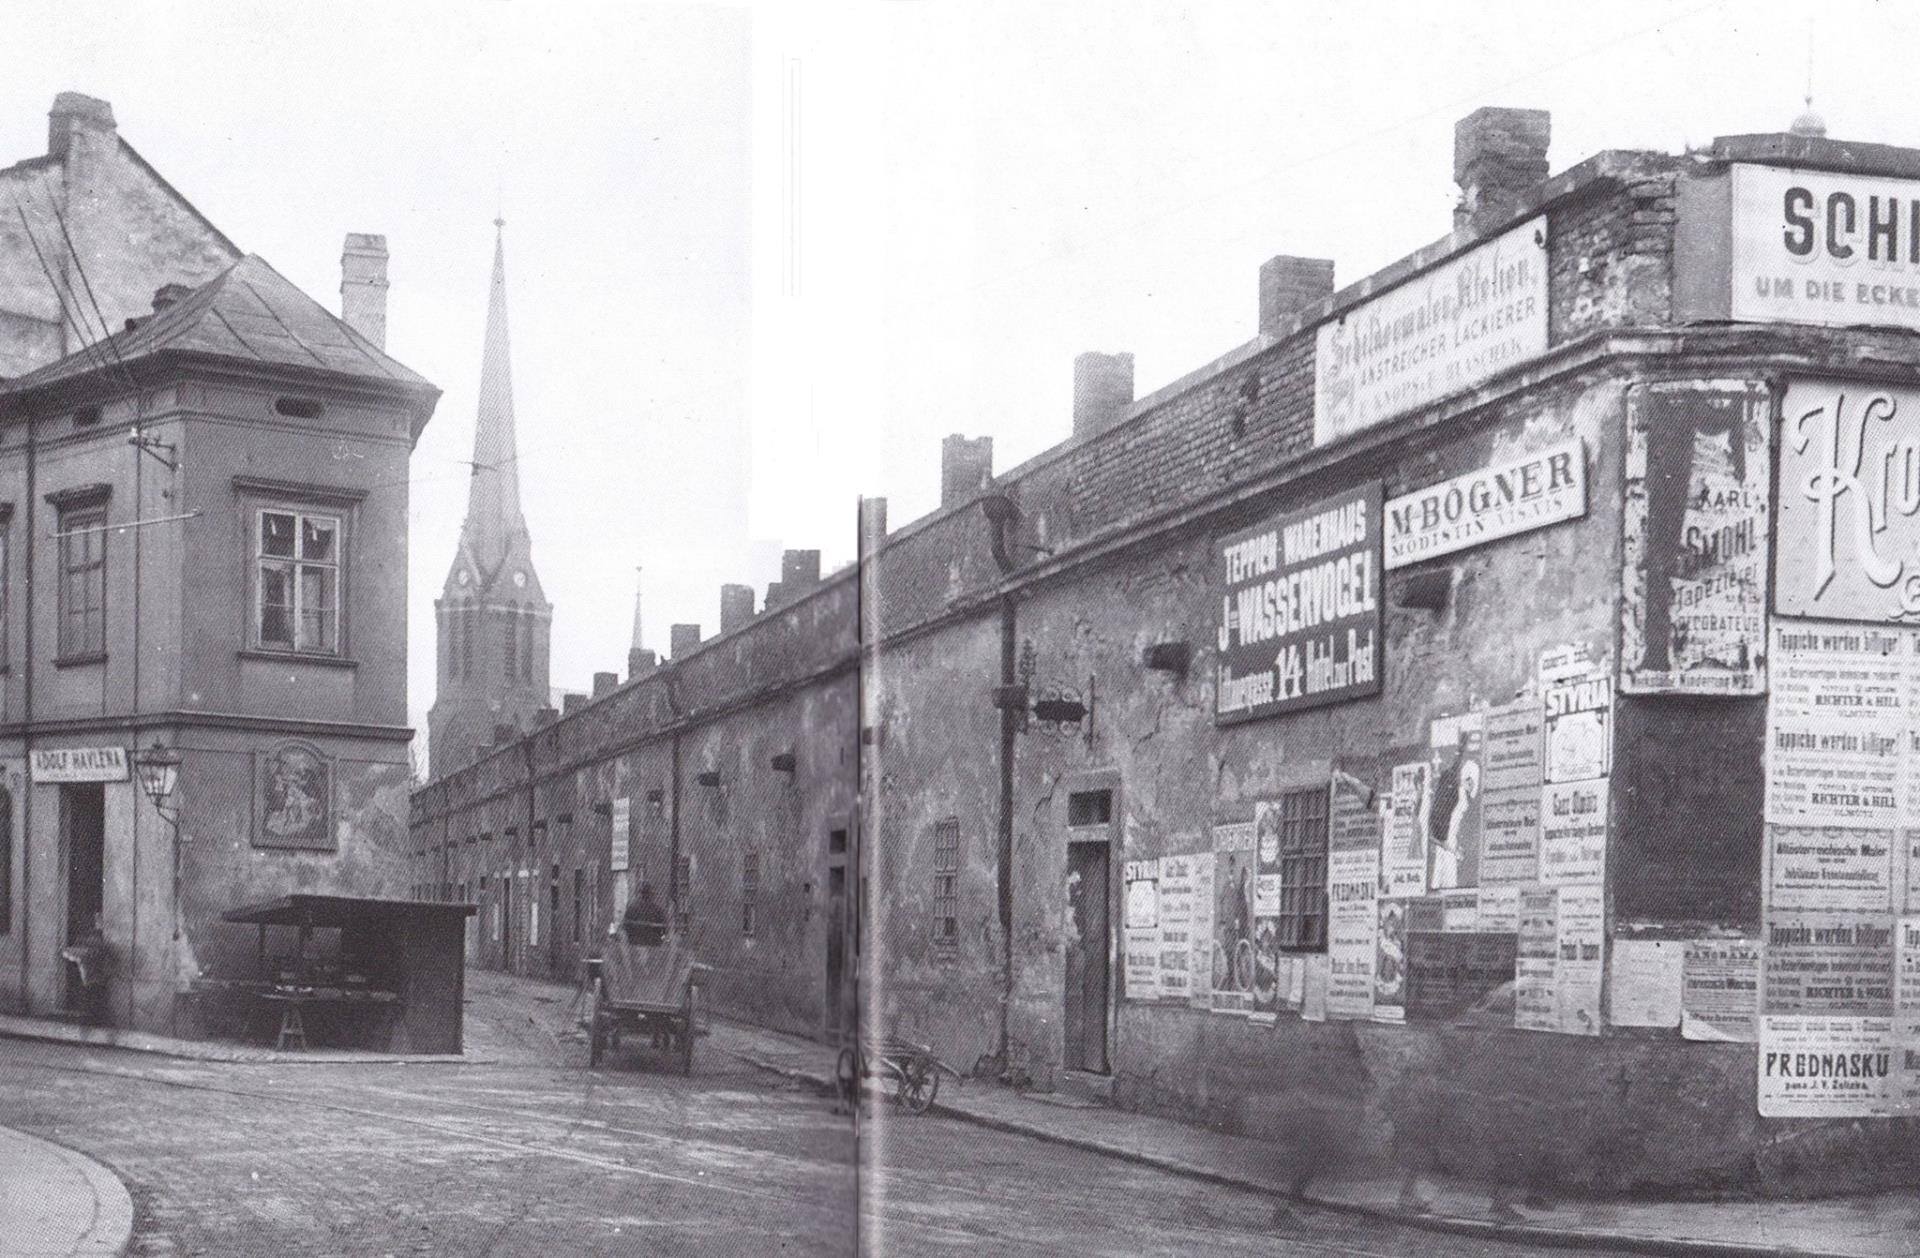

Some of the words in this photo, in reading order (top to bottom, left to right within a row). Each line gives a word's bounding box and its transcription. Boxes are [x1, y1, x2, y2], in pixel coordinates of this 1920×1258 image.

[1756, 276, 1793, 299] UM
[1806, 280, 1845, 302] DIE
[1454, 296, 1536, 348] LACKIERER
[1283, 499, 1367, 565] WARENHAUS
[1274, 644, 1303, 701] 14
[1347, 627, 1375, 686] Post
[1545, 678, 1609, 718] STYRIA
[1815, 694, 1863, 707] RICHTER
[1811, 792, 1859, 806] RICHTER
[1685, 950, 1759, 960] PANORAMA
